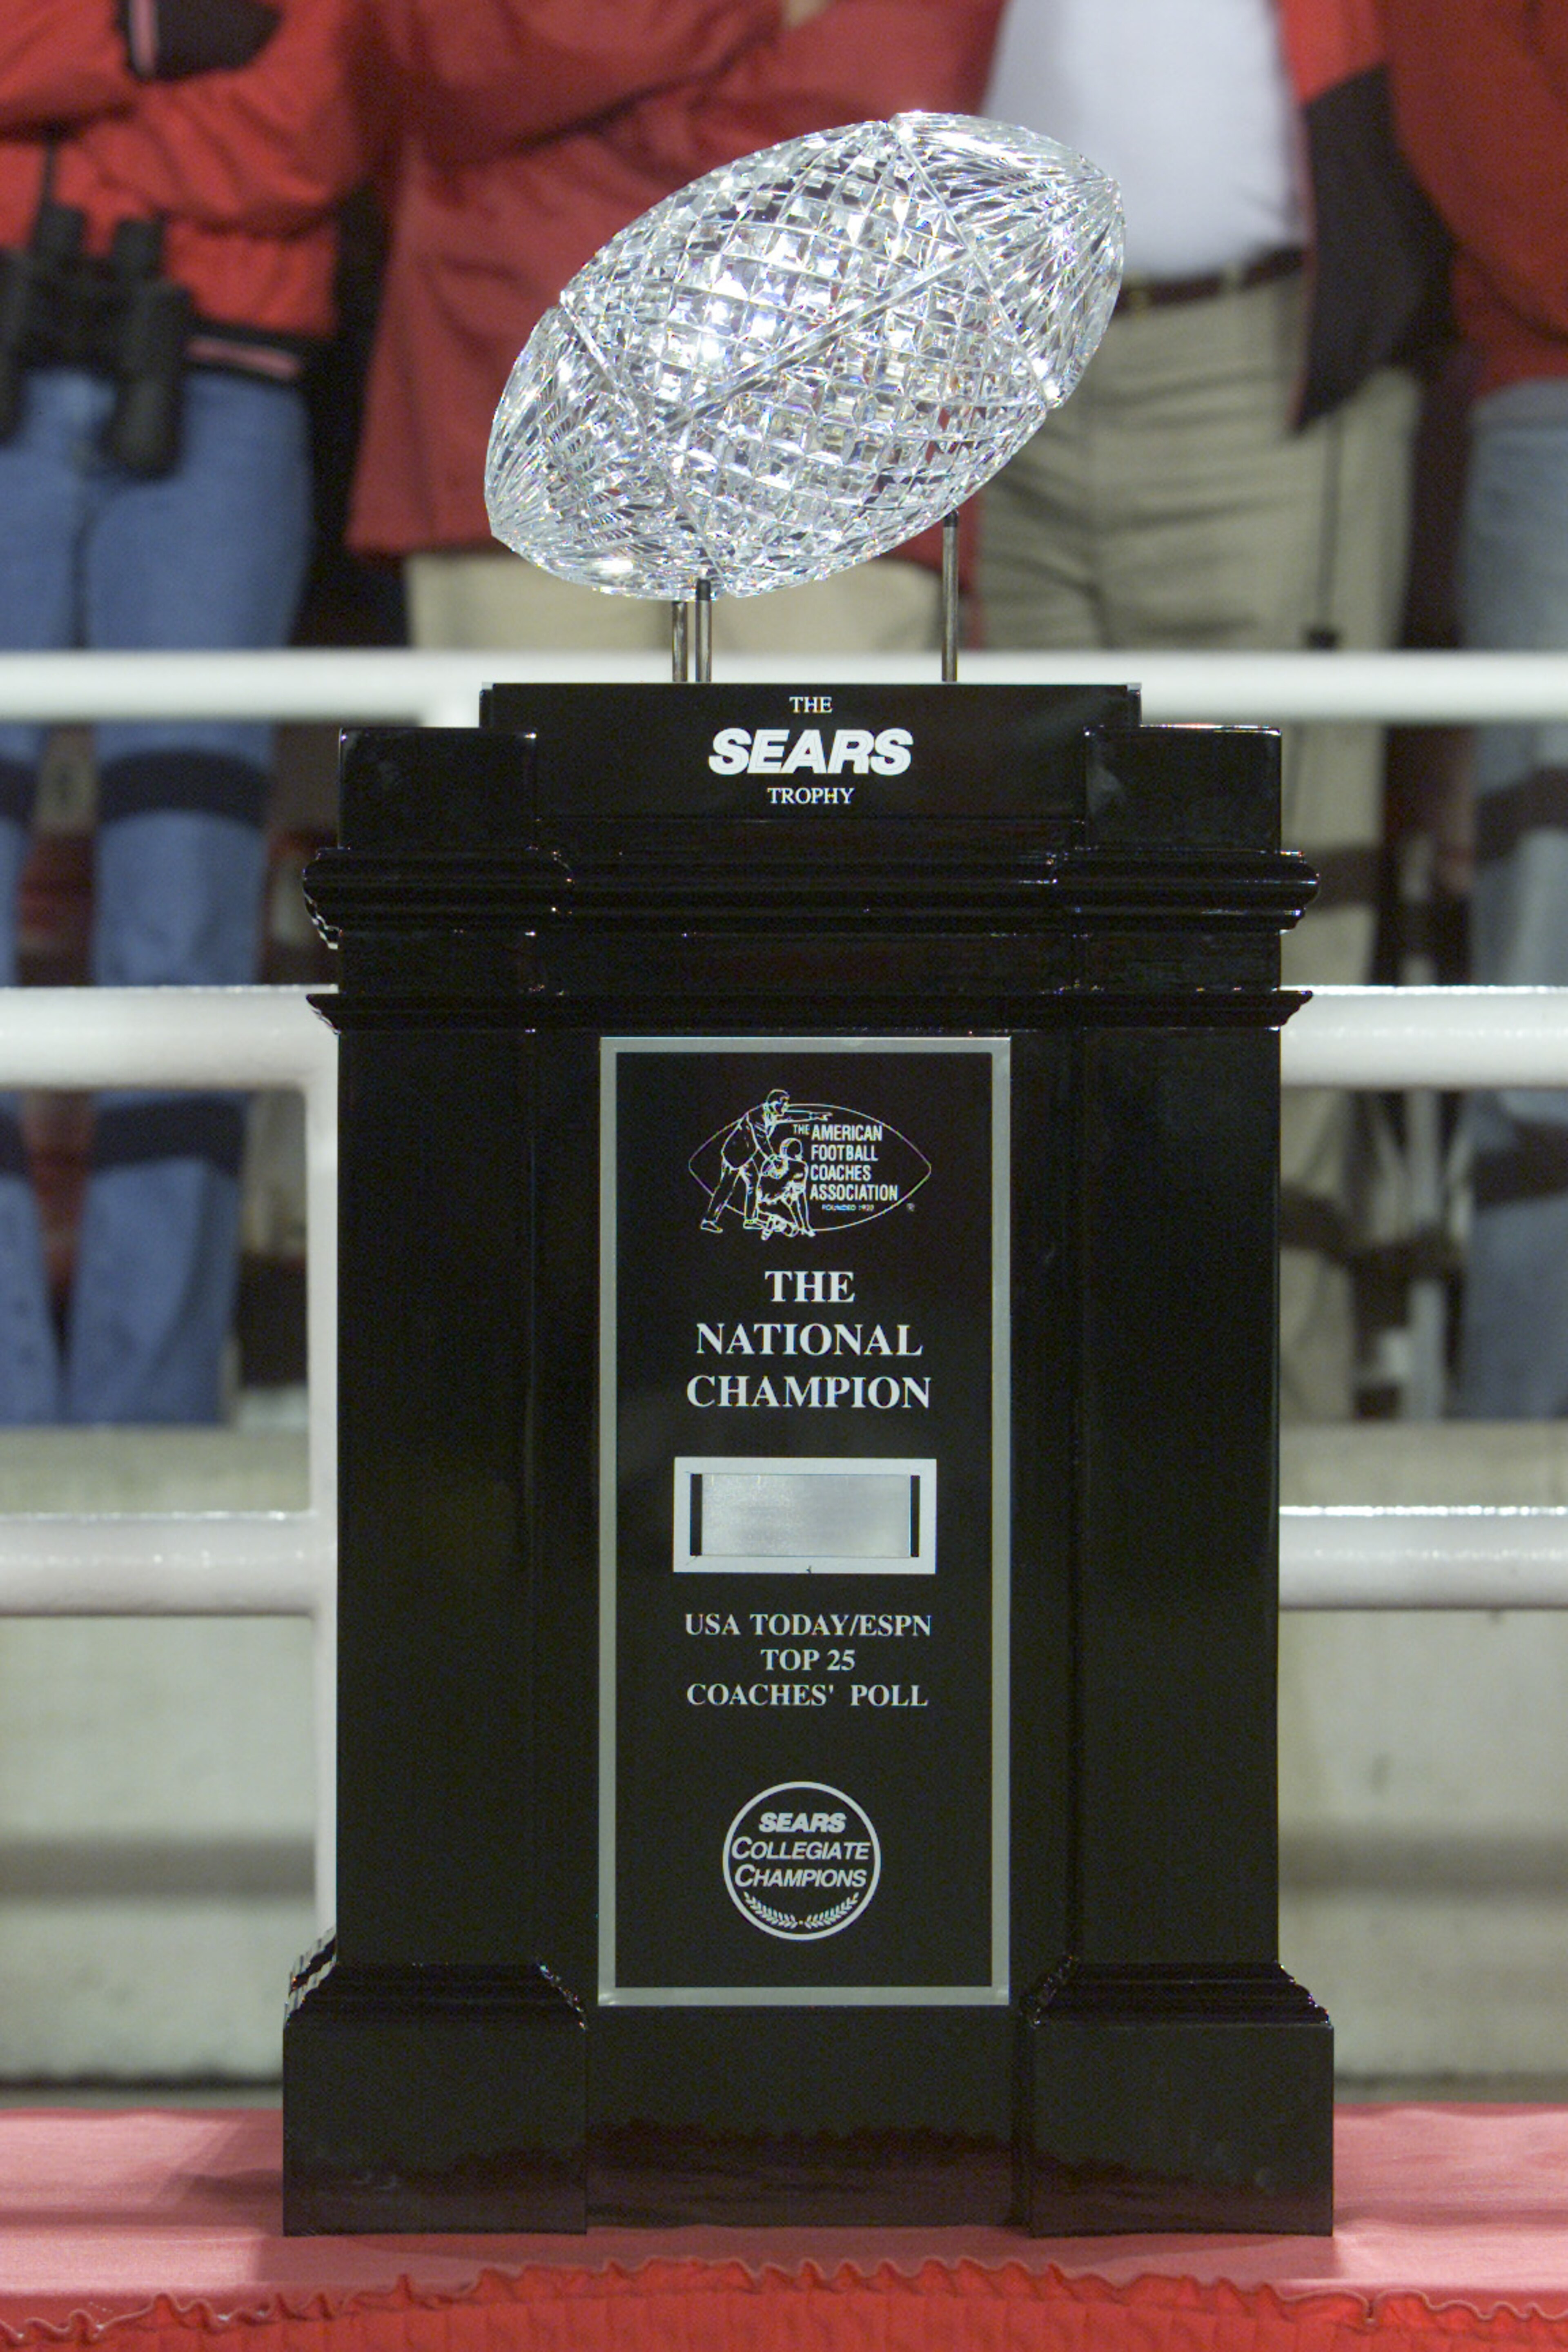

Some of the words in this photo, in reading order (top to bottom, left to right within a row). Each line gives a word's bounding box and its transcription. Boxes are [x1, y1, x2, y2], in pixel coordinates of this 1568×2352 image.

[789, 697, 832, 713] THE
[708, 728, 913, 776] SEARS
[767, 788, 855, 804] TROPHY
[793, 1124, 810, 1135] THE
[811, 1125, 882, 1141] AMERICAN
[811, 1144, 878, 1161] FOOTBALL
[810, 1164, 872, 1181] COACHES
[810, 1184, 899, 1201] ASSOCIATION
[765, 1271, 855, 1302] THE
[697, 1323, 923, 1356] NATIONAL
[687, 1375, 931, 1408] CHAMPION
[686, 1614, 740, 1635] USA
[750, 1614, 931, 1636] TODAY/ESPN
[761, 1649, 820, 1670] TOP
[827, 1650, 855, 1671] 25
[687, 1684, 833, 1706] COACHES'
[851, 1685, 929, 1706] POLL
[759, 1812, 846, 1833] SEARS
[732, 1836, 871, 1860] COLLEGIATE
[735, 1864, 867, 1887] CHAMPIONS
